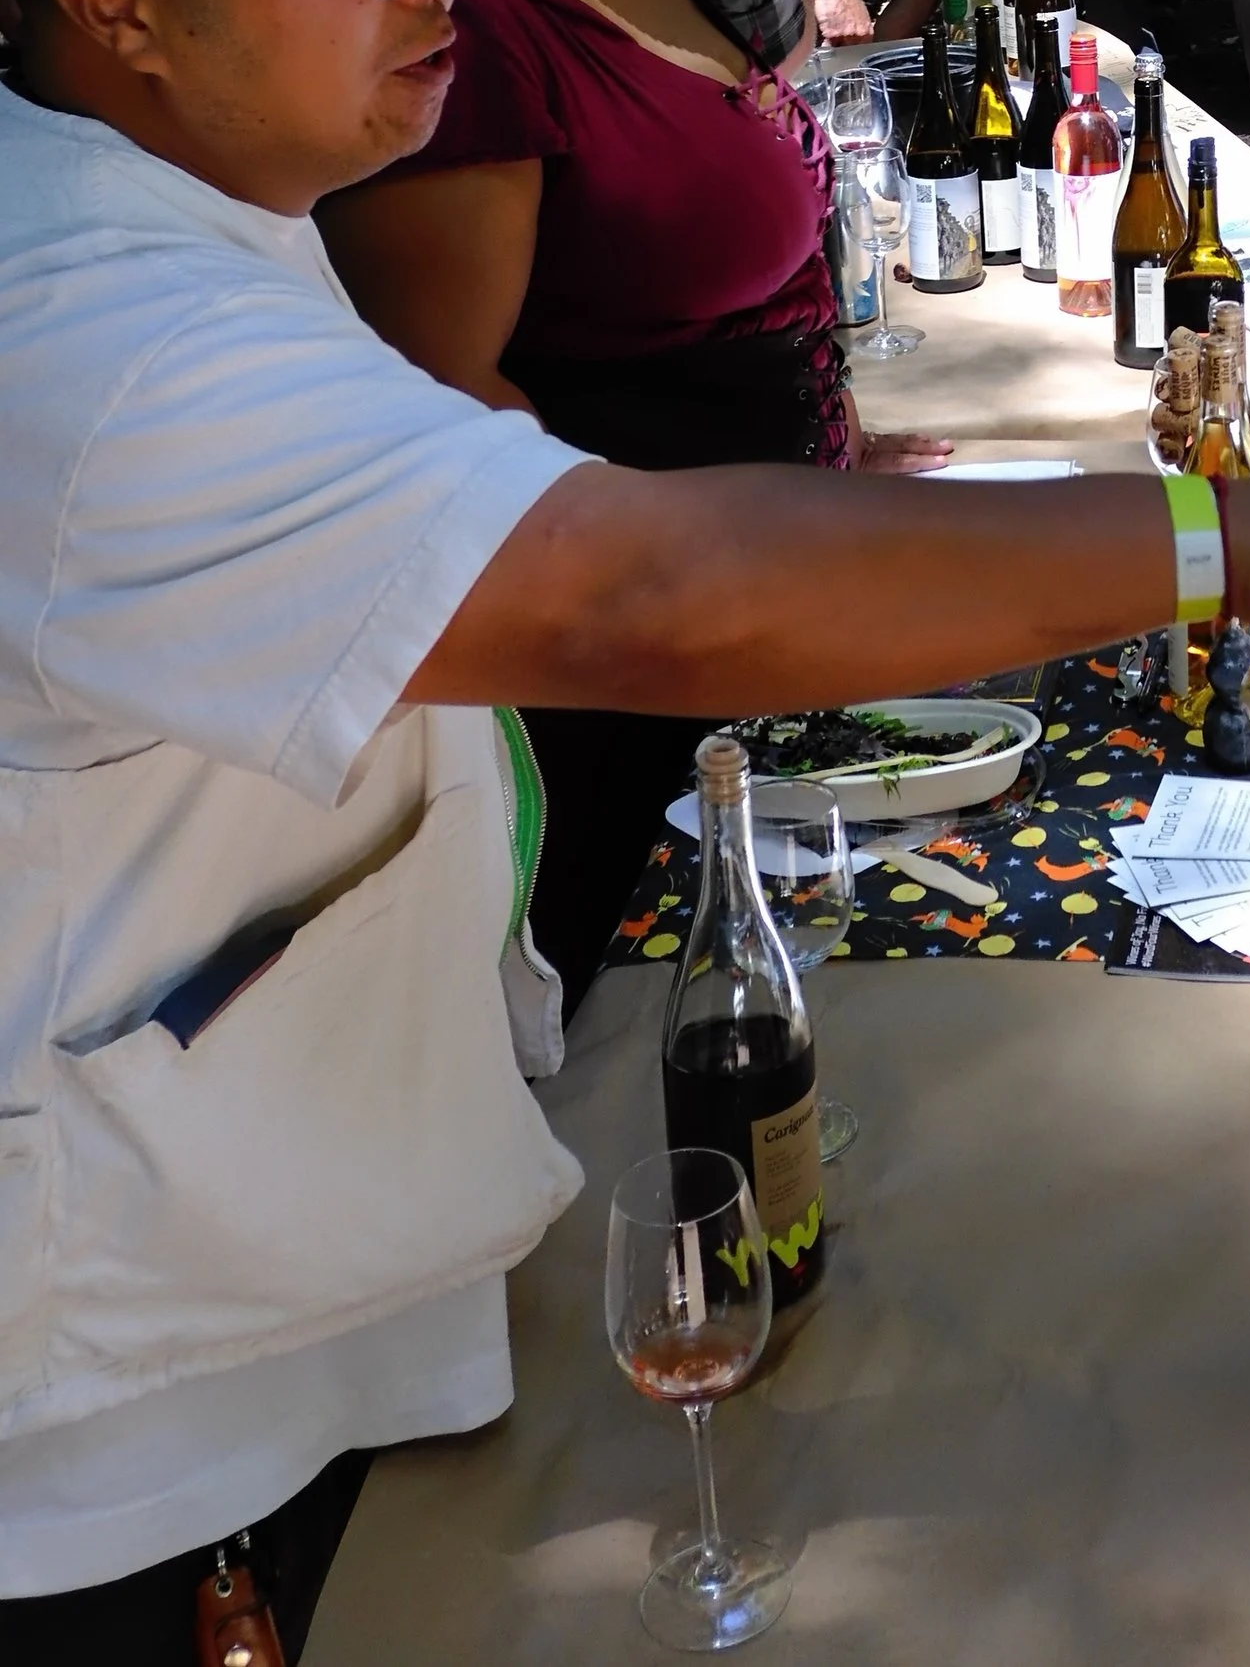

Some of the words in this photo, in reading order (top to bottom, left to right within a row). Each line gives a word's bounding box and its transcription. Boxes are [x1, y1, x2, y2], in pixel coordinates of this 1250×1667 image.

[1212, 356, 1221, 391] WINES
[1165, 785, 1193, 808] You
[1148, 812, 1183, 848] Thank
